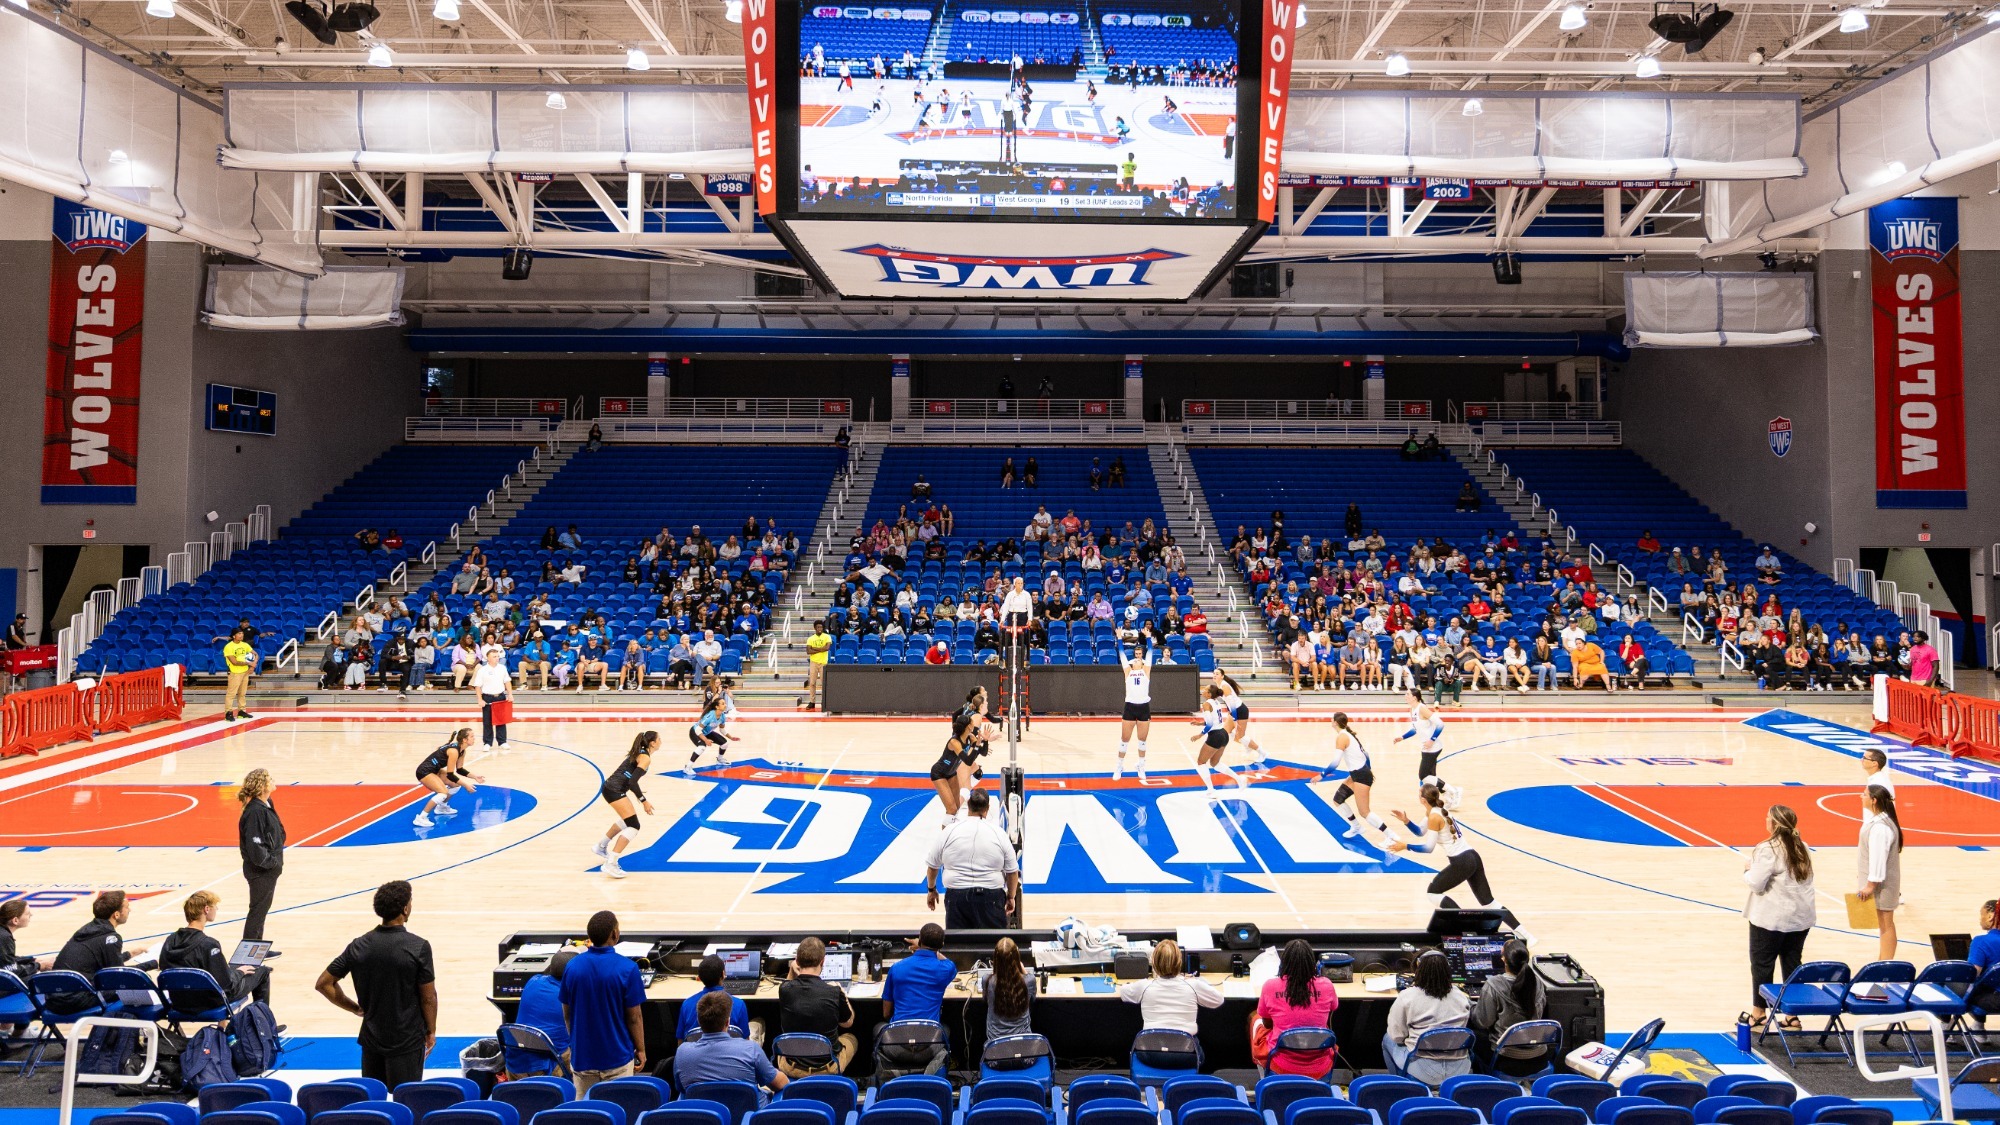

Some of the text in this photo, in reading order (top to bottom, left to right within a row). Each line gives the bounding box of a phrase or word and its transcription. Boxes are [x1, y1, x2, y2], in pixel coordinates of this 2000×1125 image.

[748, 0, 773, 194] WOLVES
[1262, 0, 1291, 201] WOLVES
[717, 183, 743, 192] 1998
[1426, 177, 1468, 188] BASKETBALL
[1433, 187, 1462, 198] 2002
[968, 197, 979, 205] 11
[1060, 198, 1070, 206] 19
[75, 210, 124, 242] UWG
[1888, 220, 1937, 251] UWG
[892, 257, 1137, 289] UWG
[70, 264, 117, 470] WOLVES
[1895, 273, 1939, 475] WOLVES
[1777, 421, 1789, 430] WEST
[1770, 432, 1790, 454] UWG
[1134, 677, 1141, 685] 16
[667, 785, 1383, 885] UWG
